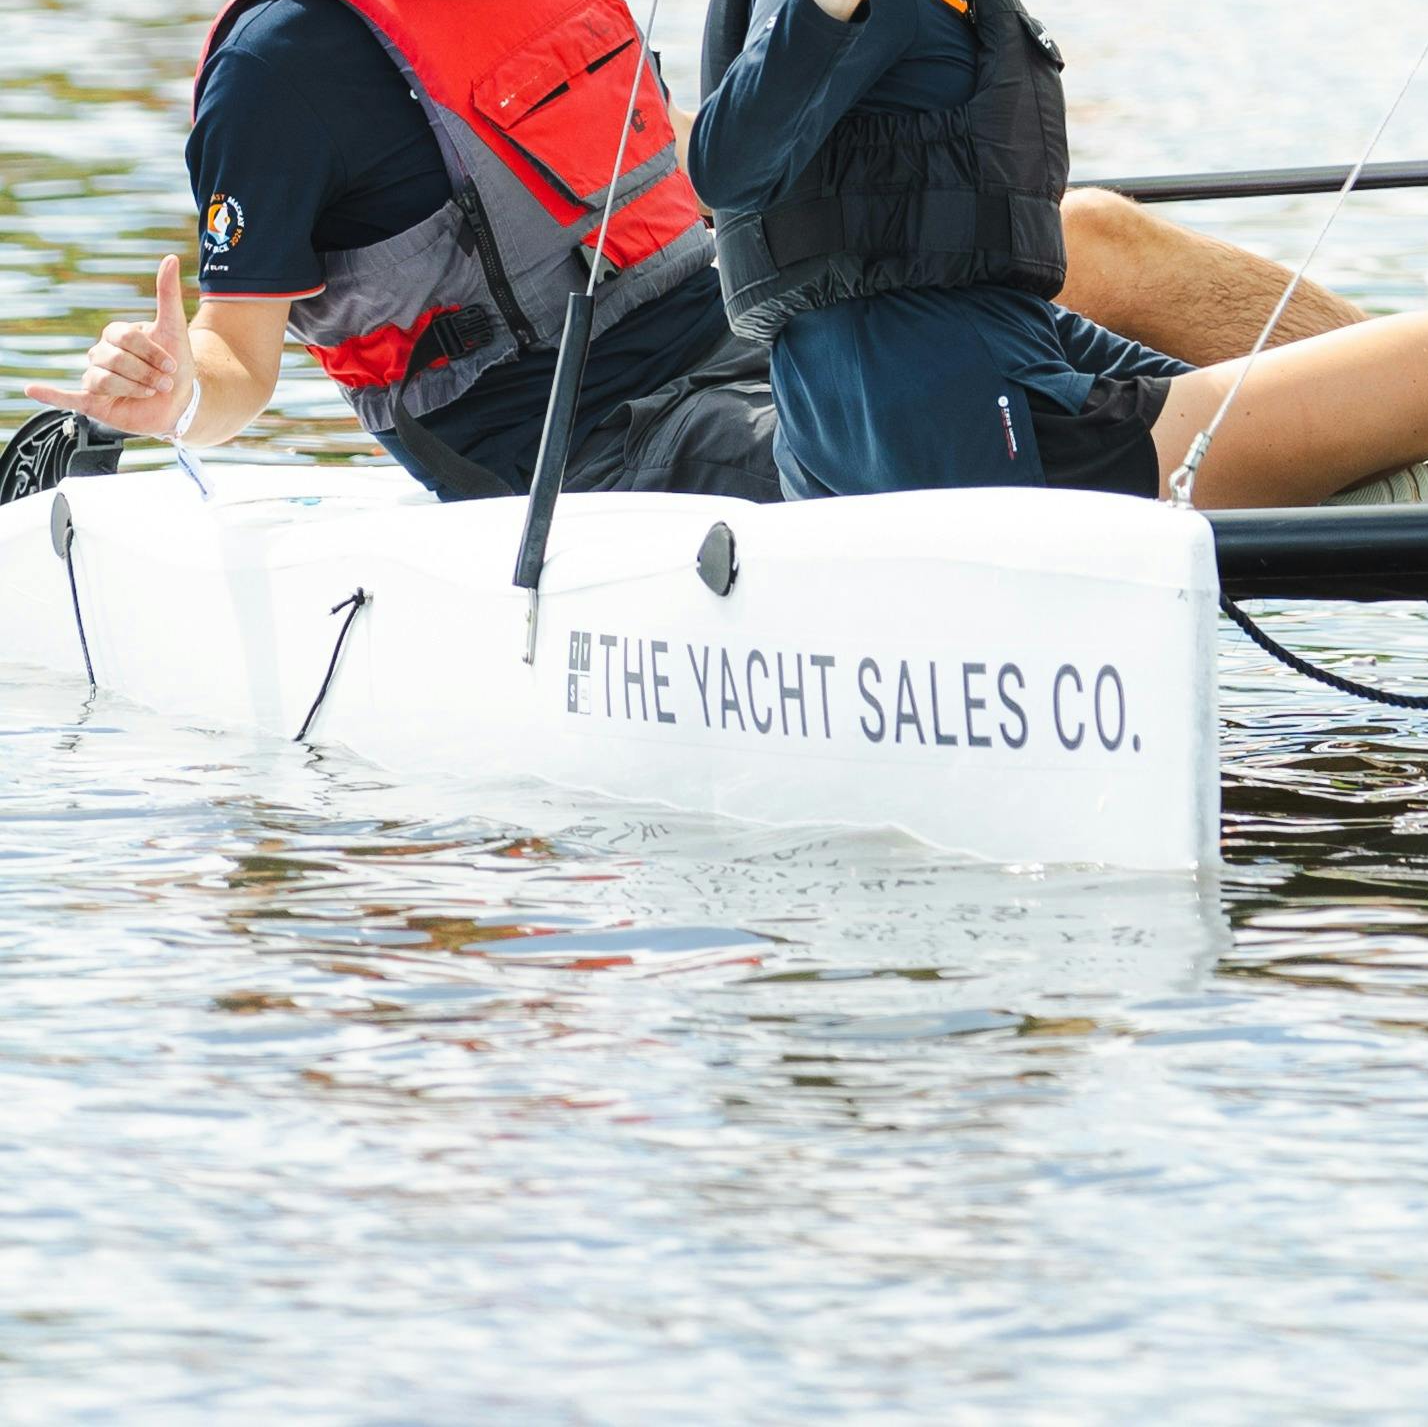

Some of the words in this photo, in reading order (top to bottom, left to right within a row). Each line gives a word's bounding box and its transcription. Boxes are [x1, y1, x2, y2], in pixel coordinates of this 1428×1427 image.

[600, 634, 676, 725] THE
[686, 643, 836, 739] YACHT
[857, 656, 1029, 749] SALES
[1052, 662, 1141, 753] CO.
